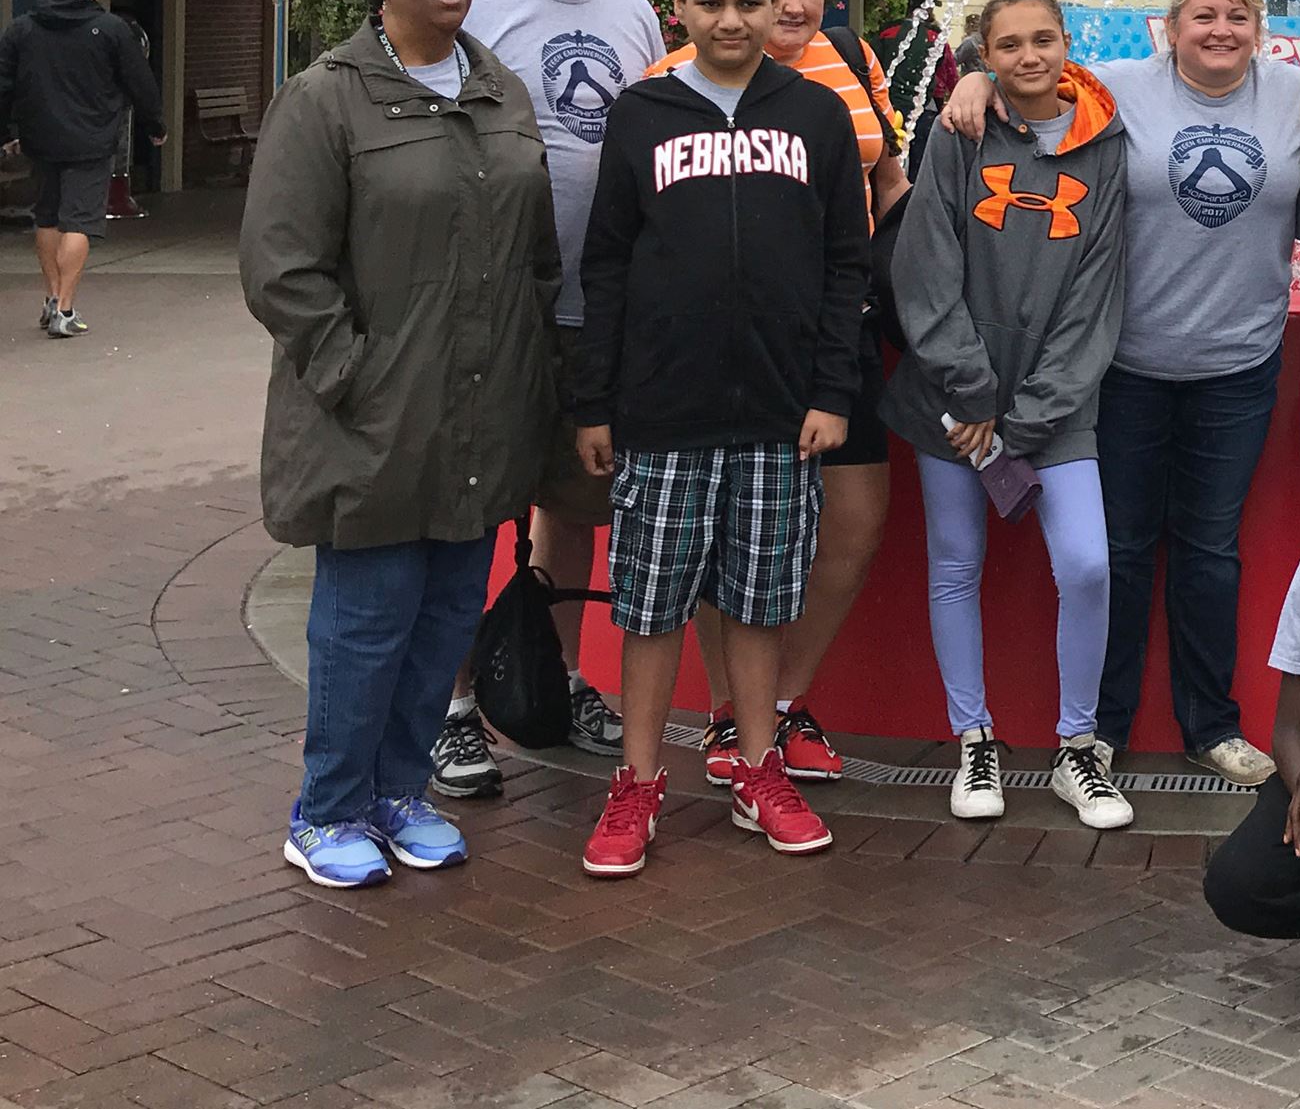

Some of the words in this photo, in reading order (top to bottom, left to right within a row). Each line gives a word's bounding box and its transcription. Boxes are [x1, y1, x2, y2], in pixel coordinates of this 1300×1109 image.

[547, 53, 563, 68] TEEN
[563, 48, 618, 72] EMPOWERMENT
[560, 102, 601, 117] HOPKINS
[581, 123, 601, 131] 2017
[1177, 139, 1196, 152] TEEN
[1196, 136, 1258, 158] EMPOWERMENT
[654, 129, 809, 194] NEBRASKA
[1183, 185, 1230, 203] HOPKINS
[1201, 208, 1225, 216] 2017
